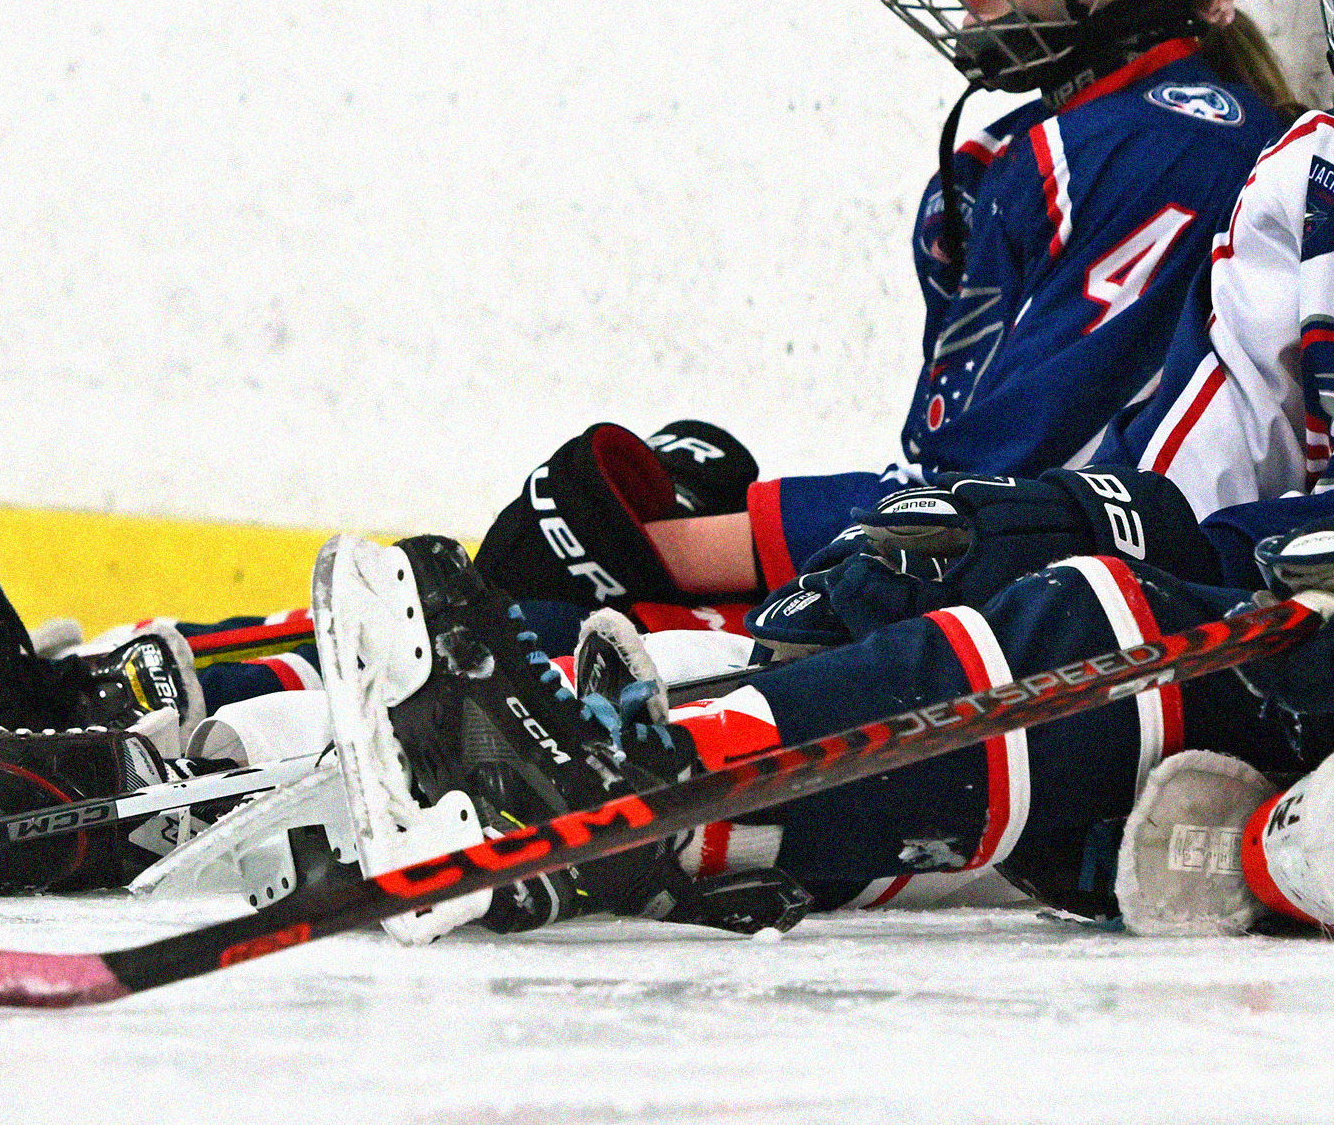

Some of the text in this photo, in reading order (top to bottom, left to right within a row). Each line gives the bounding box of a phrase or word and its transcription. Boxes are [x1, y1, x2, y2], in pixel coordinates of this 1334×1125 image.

[1081, 201, 1198, 336] 4
[505, 696, 572, 765] CCM
[898, 643, 1161, 738] JETSPEED
[18, 805, 110, 835] CCM
[375, 794, 655, 899] CCM
